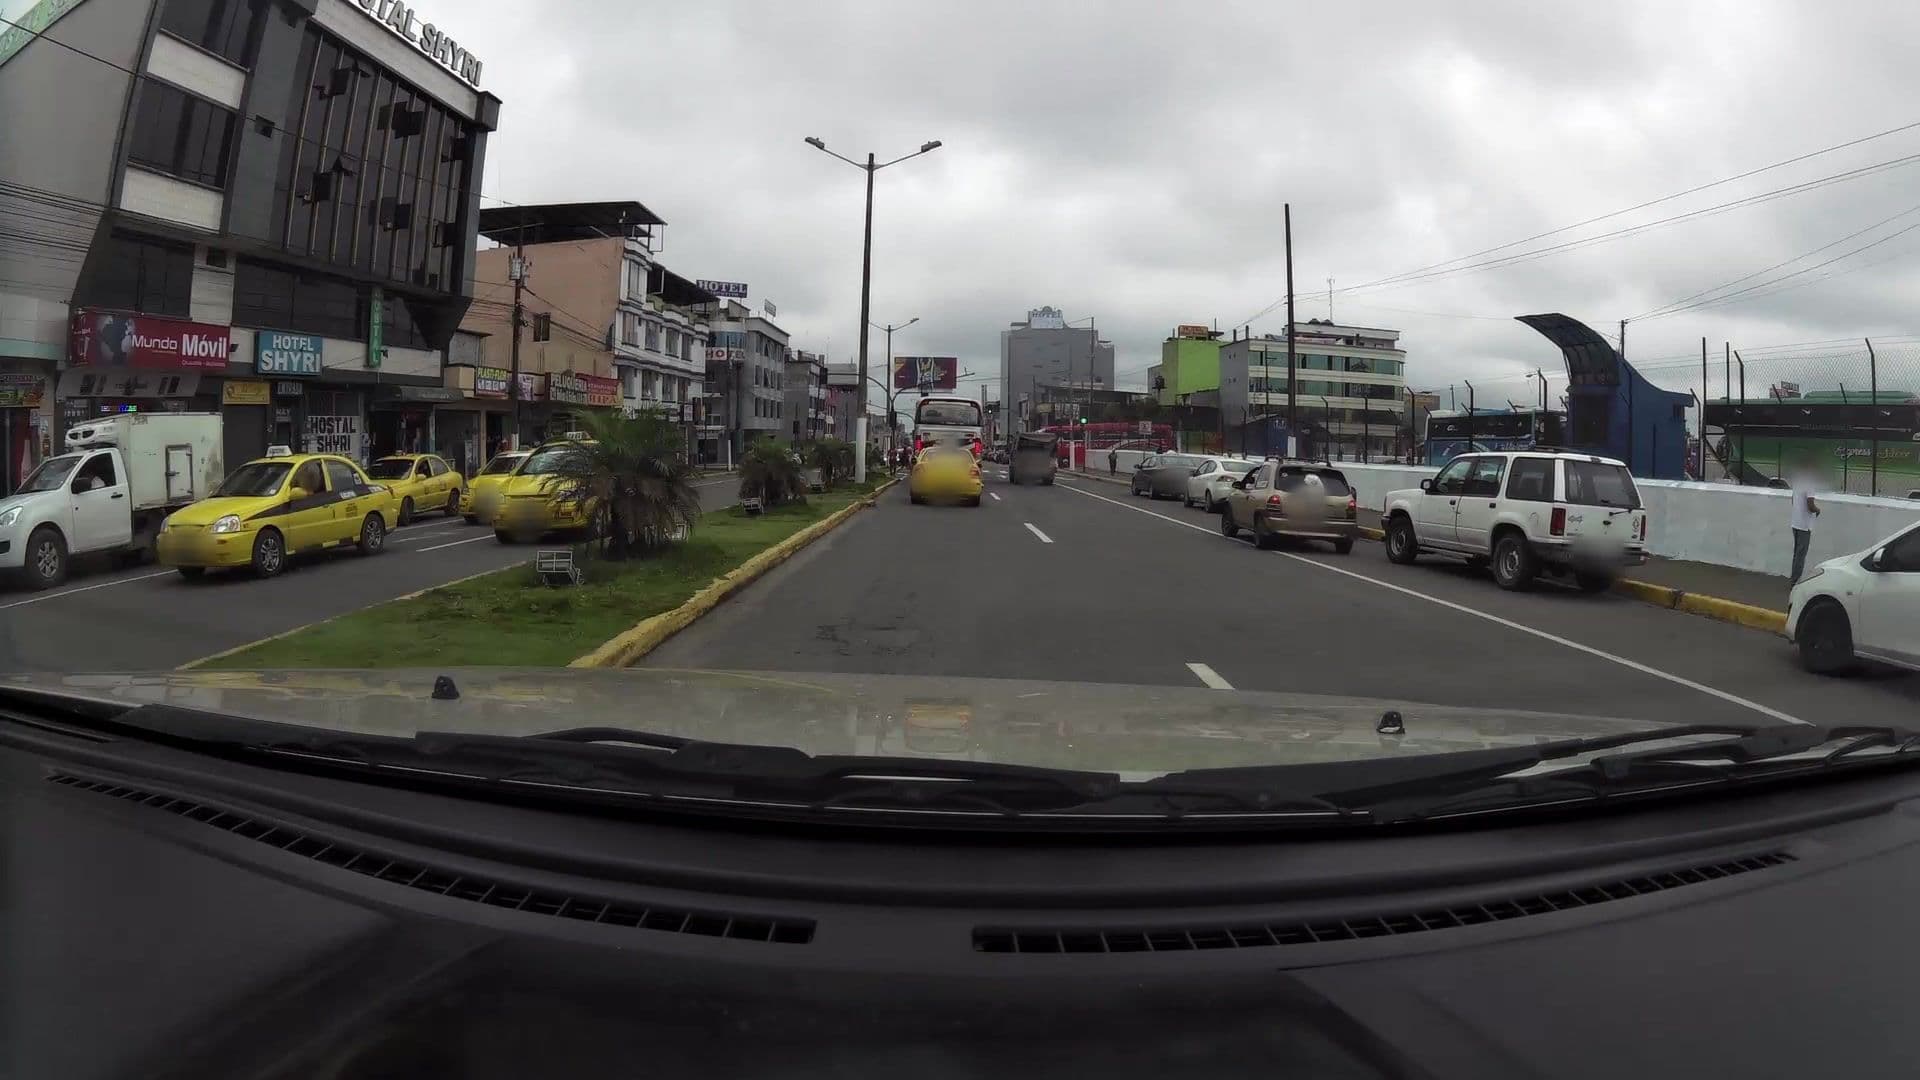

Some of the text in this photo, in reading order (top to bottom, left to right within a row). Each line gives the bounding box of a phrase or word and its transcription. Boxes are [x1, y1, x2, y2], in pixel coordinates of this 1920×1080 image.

[420, 22, 483, 87] SHYRI
[697, 280, 747, 294] HOTEL
[131, 332, 227, 359] Mundo Móvil
[272, 334, 314, 351] HOTEL
[261, 350, 321, 373] SHYRI
[310, 417, 356, 434] HOSTAL
[317, 435, 351, 452] SHYRI
